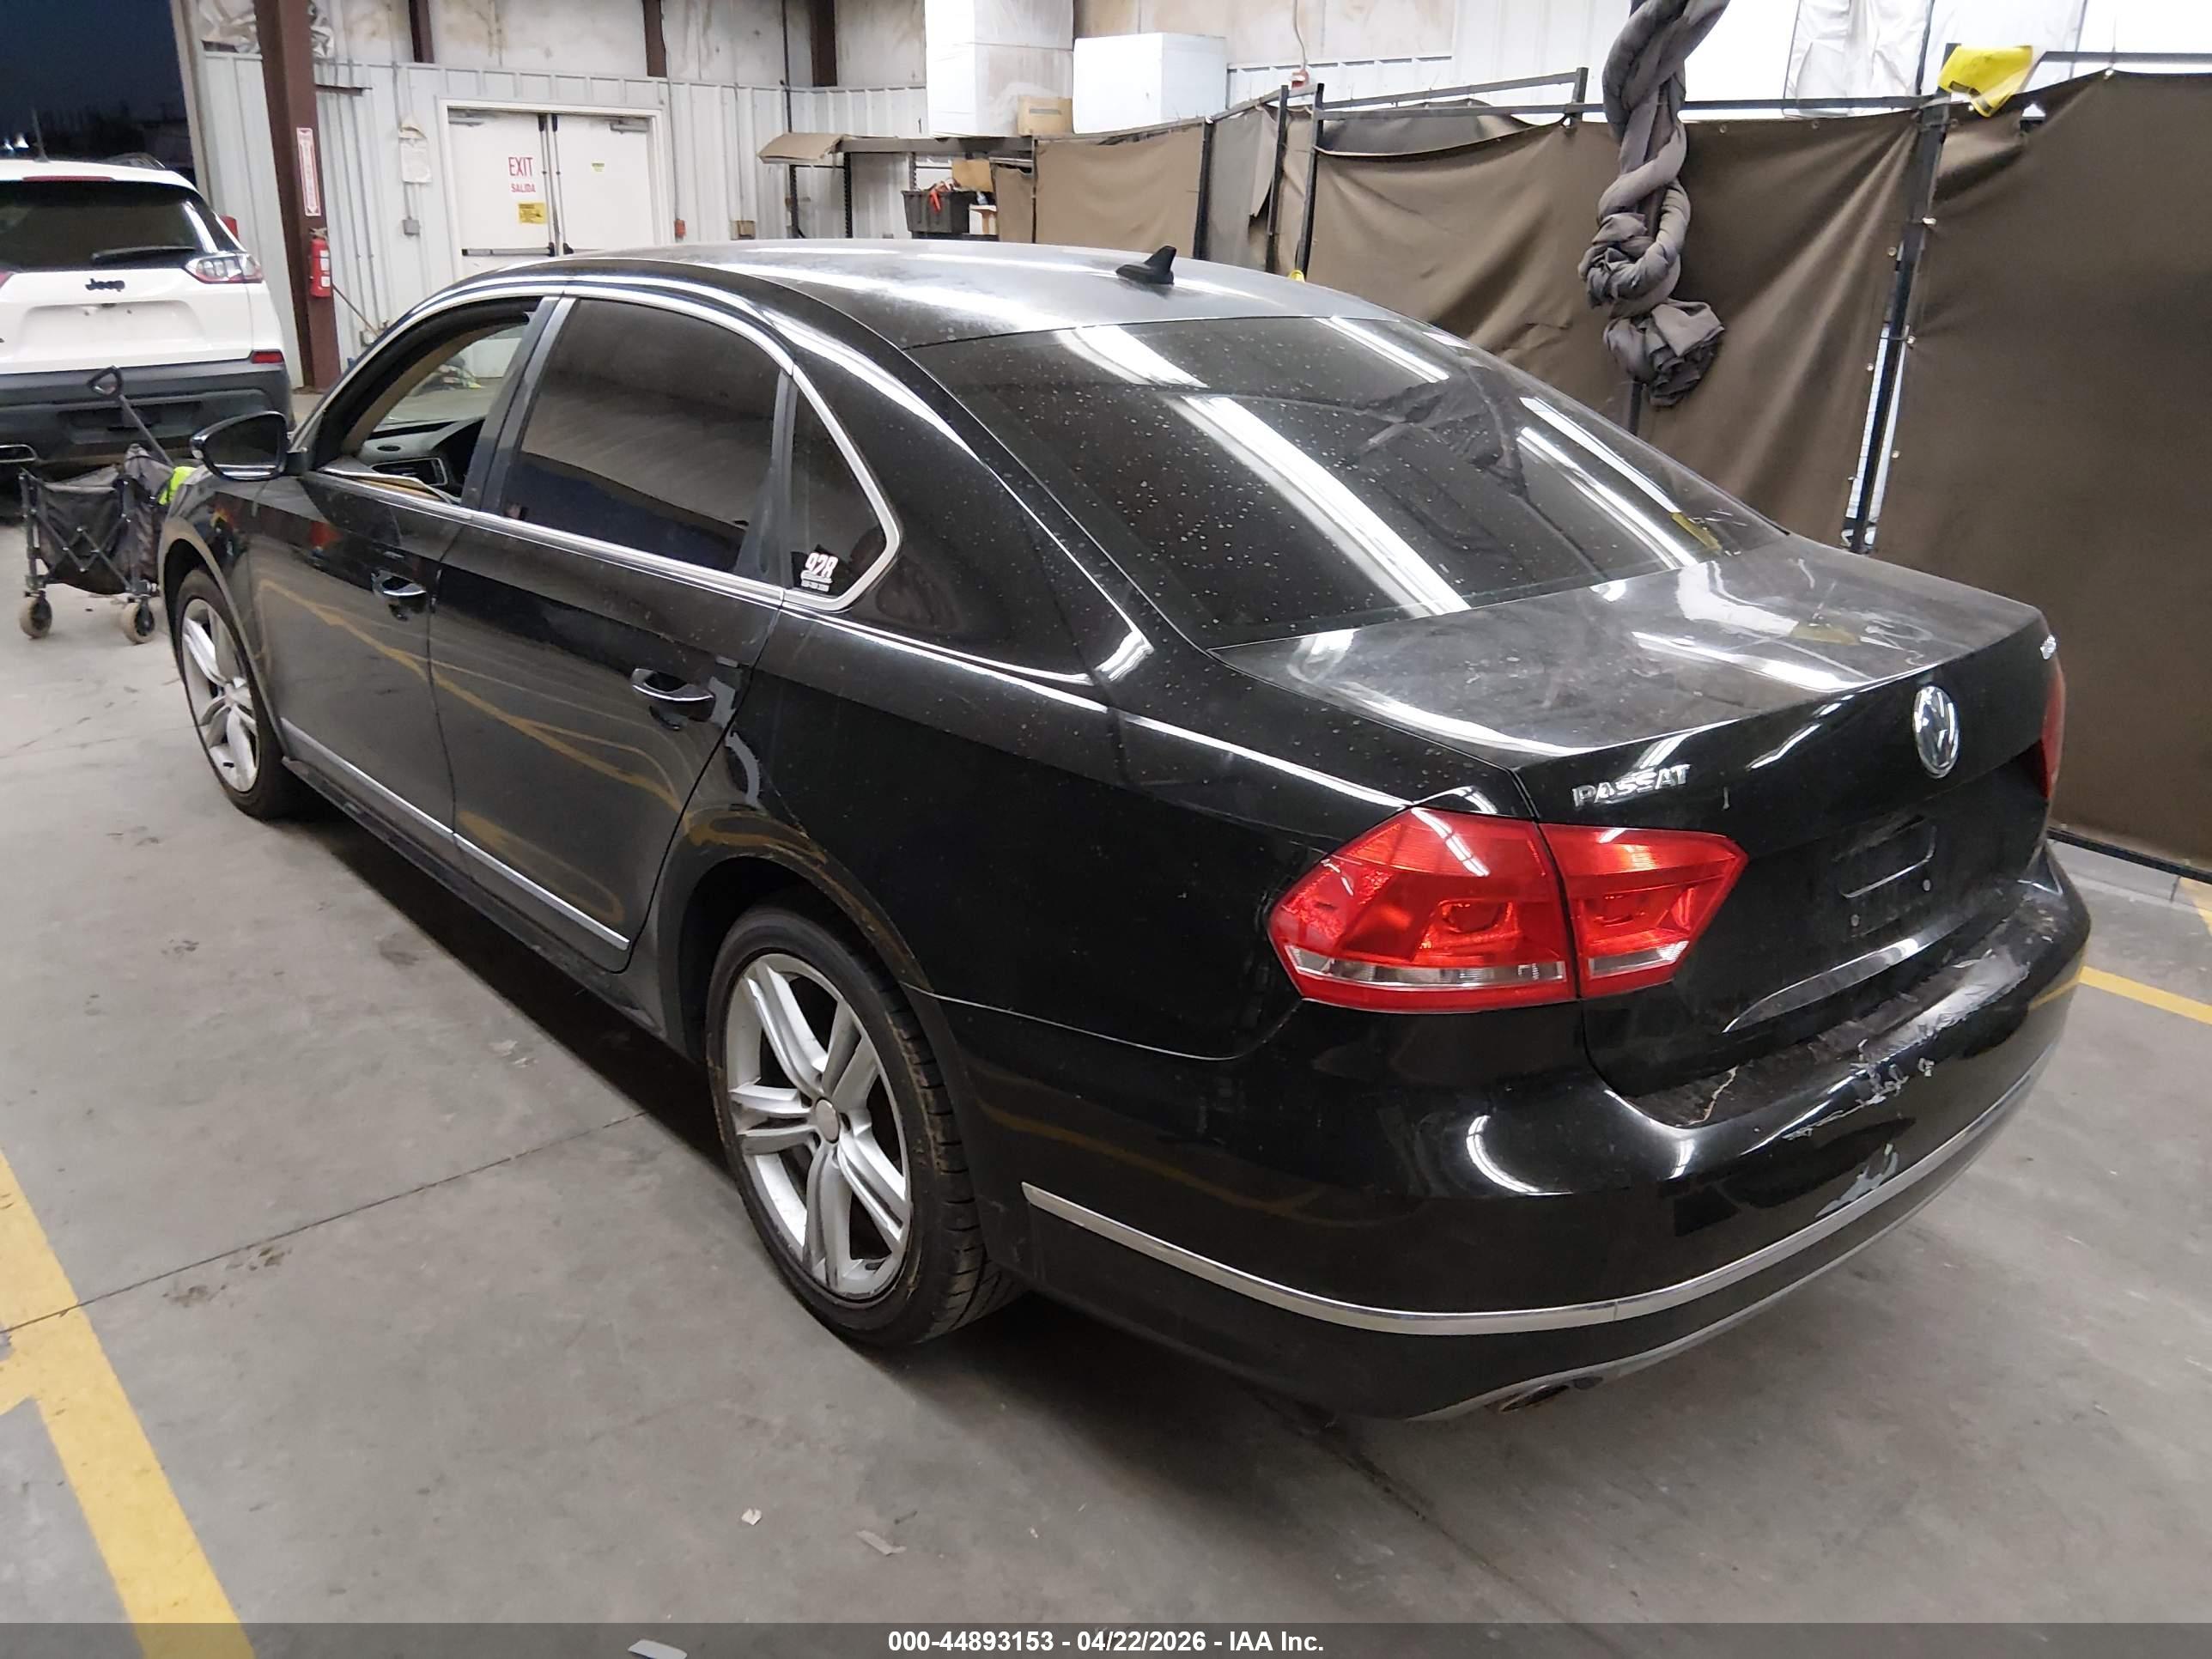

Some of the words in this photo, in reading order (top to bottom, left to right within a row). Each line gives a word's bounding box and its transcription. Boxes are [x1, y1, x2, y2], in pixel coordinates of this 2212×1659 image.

[507, 156, 533, 177] EXIT
[511, 183, 536, 193] SALIDA
[85, 278, 125, 292] Jeep
[805, 552, 838, 579] 928
[1571, 764, 1691, 808] PASSAT
